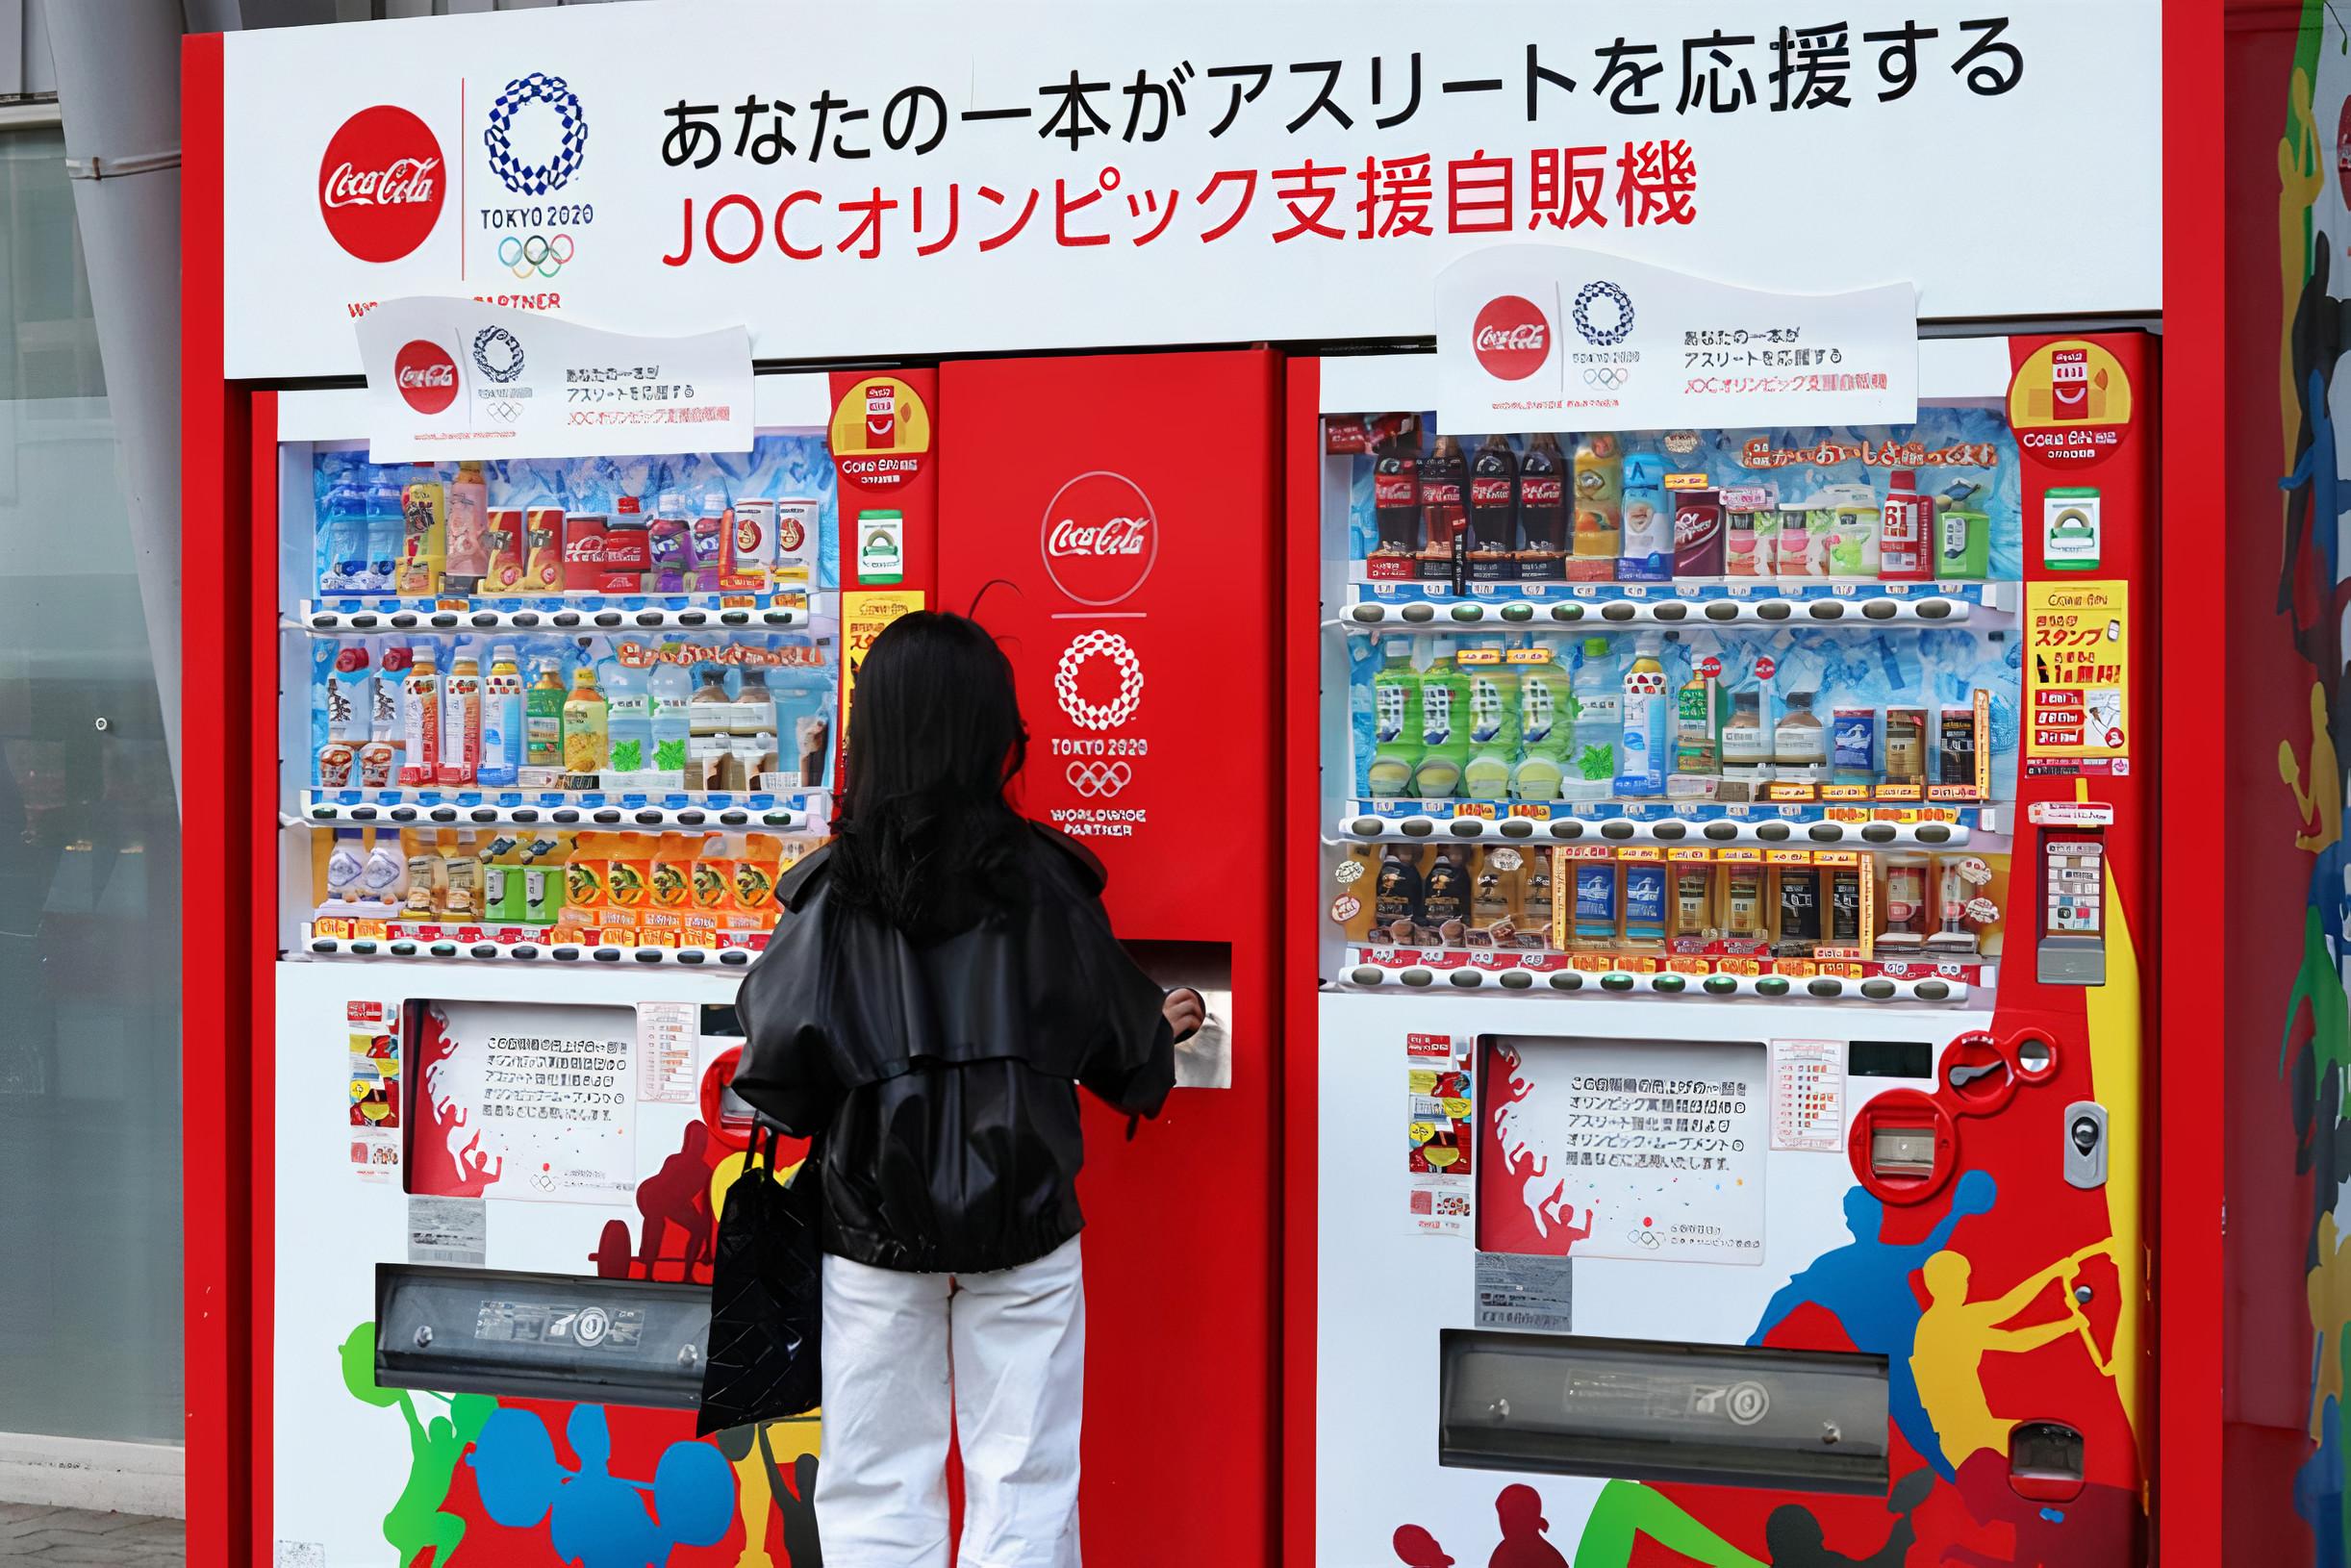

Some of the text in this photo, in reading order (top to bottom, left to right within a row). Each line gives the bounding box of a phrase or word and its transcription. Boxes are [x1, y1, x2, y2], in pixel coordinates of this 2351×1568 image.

[663, 17, 2023, 179] あなたの一本がアスリートを応援する
[662, 139, 1697, 266] JOCオリンピック支援自販機
[480, 203, 594, 230] TOKYO 2020
[474, 292, 561, 311] RTNER
[1051, 738, 1104, 755] TOKYO
